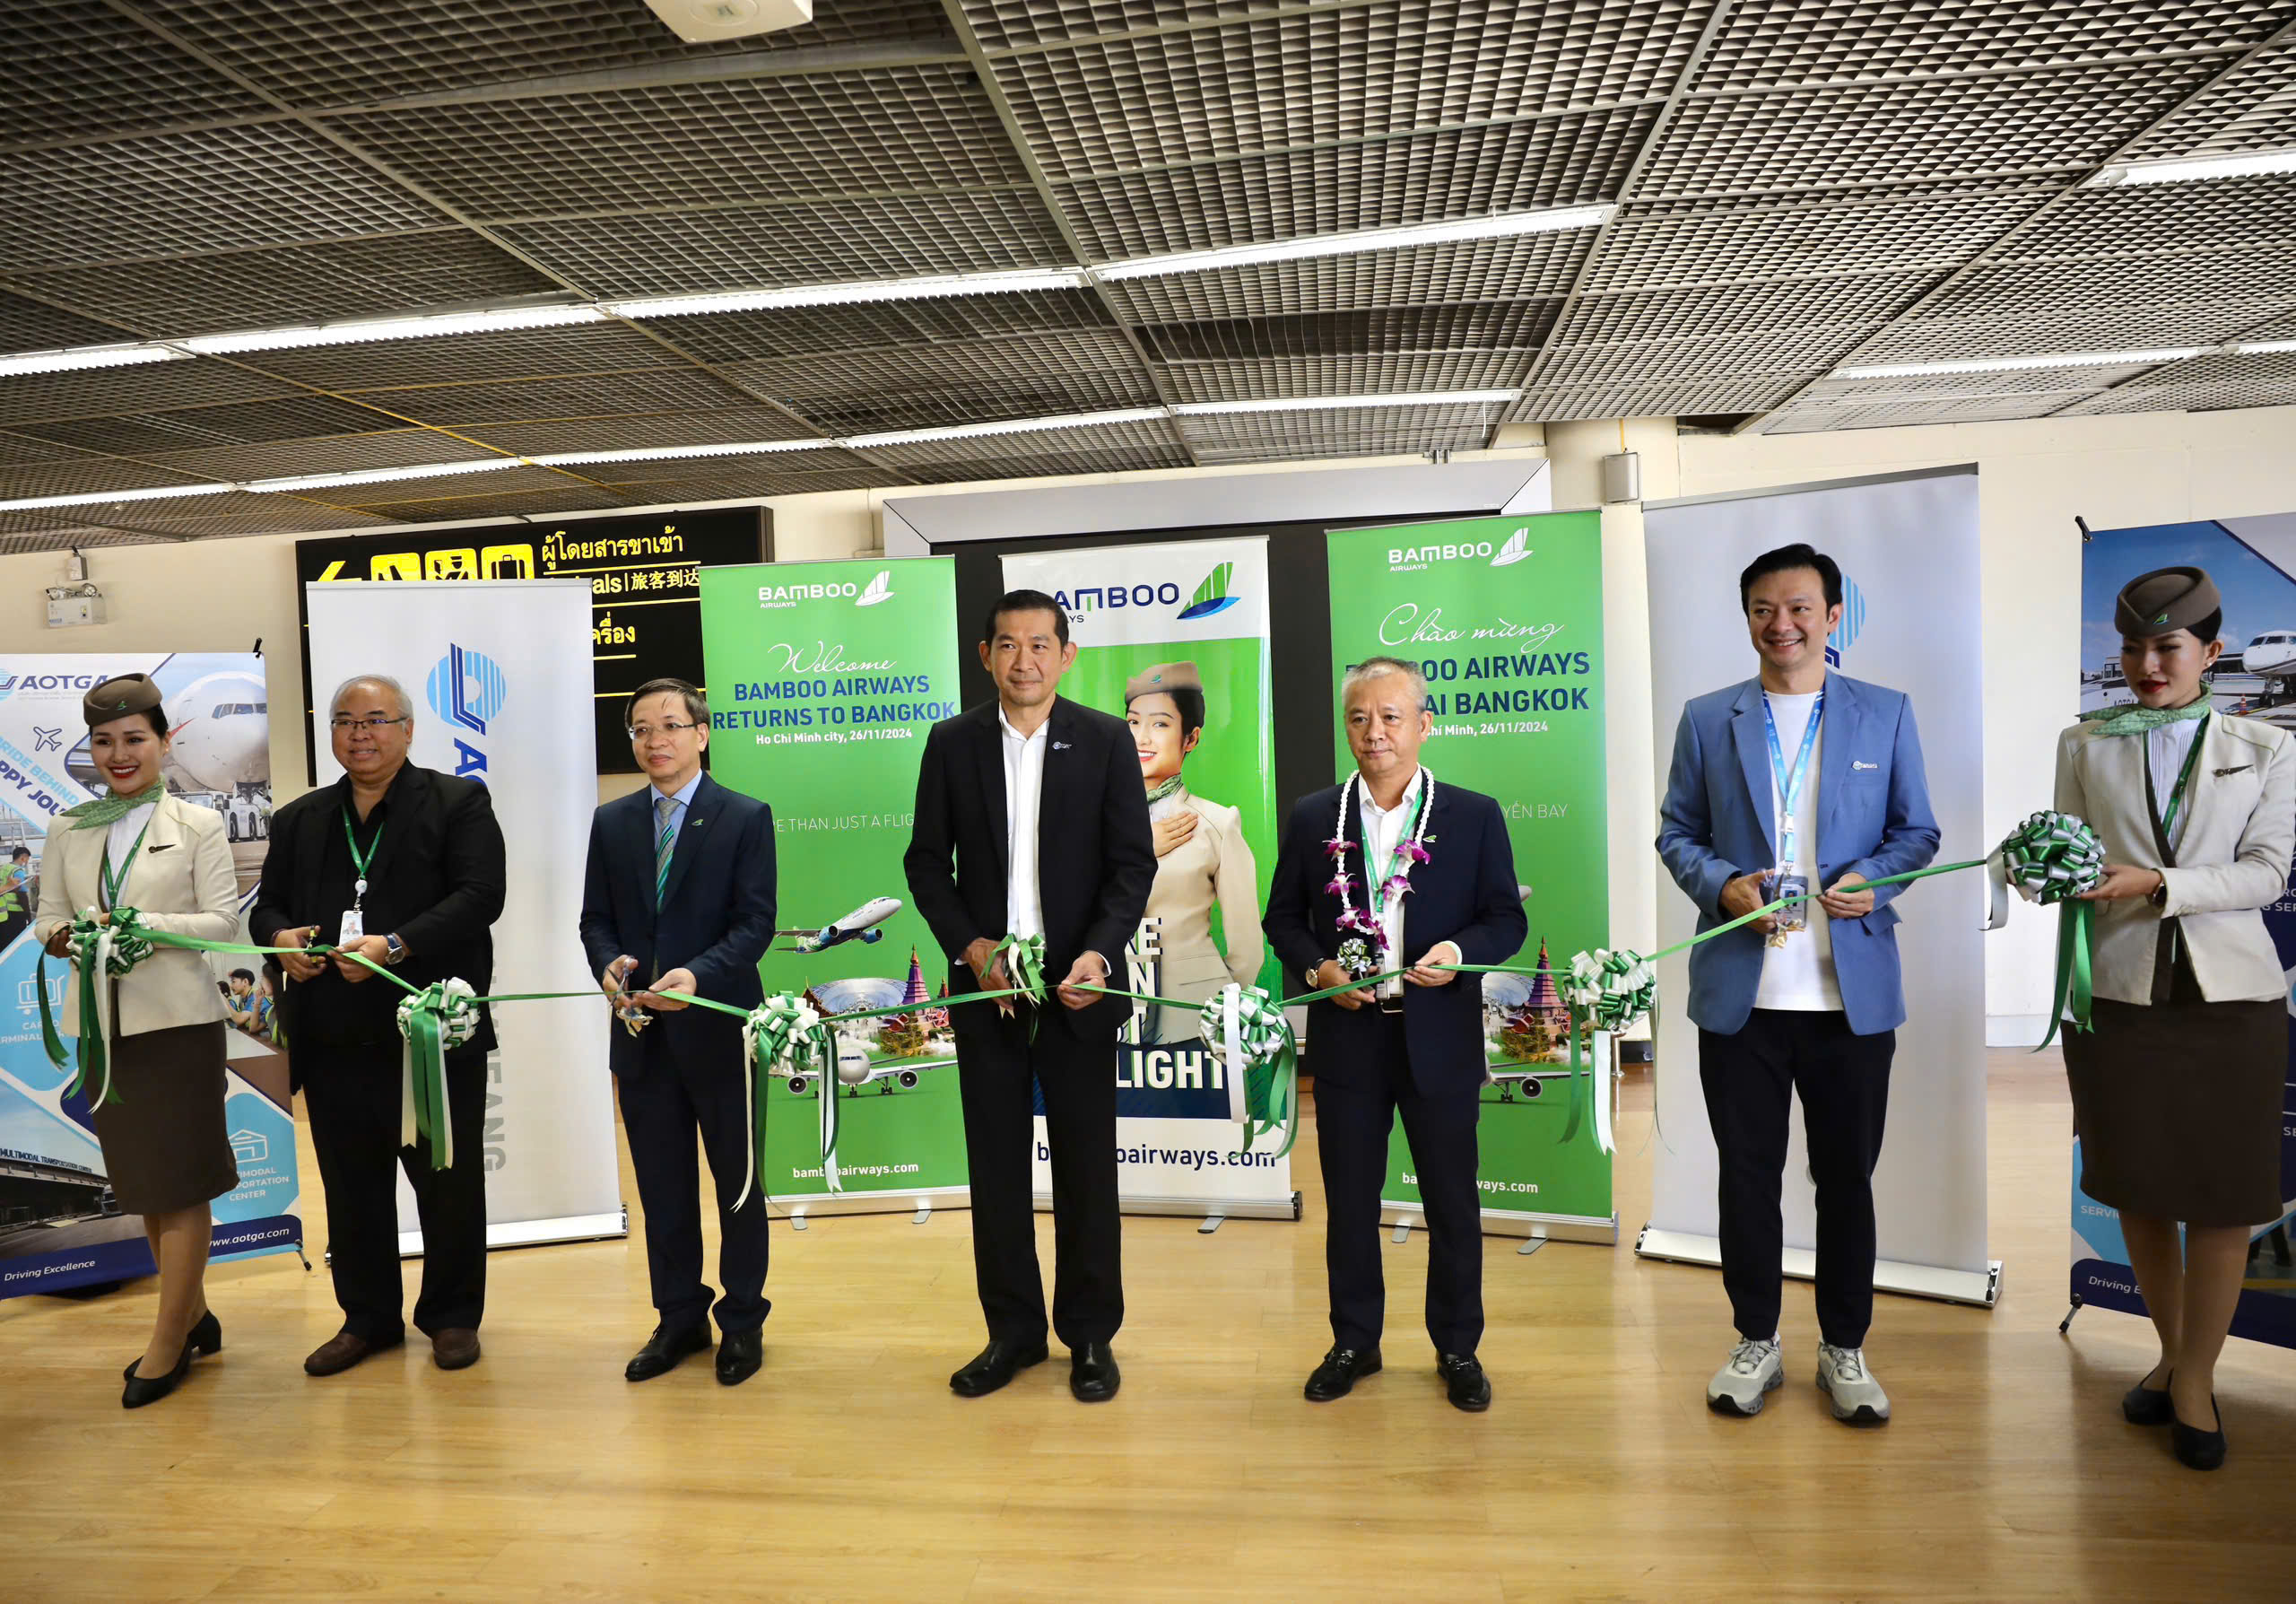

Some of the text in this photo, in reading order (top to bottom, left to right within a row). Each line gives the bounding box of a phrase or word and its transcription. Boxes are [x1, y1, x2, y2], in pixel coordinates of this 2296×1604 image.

[542, 526, 683, 571] ผู้โดยสารขาเข้า
[1388, 542, 1492, 563] BAMBOO
[1389, 563, 1428, 572] AIRWAYS
[758, 582, 857, 600] BAMBOO
[760, 601, 797, 609] AIRWAYS
[1378, 603, 1466, 646] Chào
[767, 641, 898, 674] Welcome
[1464, 652, 1590, 679] AIRWAYS
[735, 675, 930, 701] BAMBOO AIRWAYS
[1455, 687, 1589, 715] BANGKOK
[712, 702, 955, 729] RETURNS TO BANGKOK
[756, 728, 912, 745] Ho Chi Minh city, 26/11/2024
[1445, 724, 1478, 737] Minh,
[1480, 720, 1549, 734] 26/11/2024
[0, 735, 33, 768] RIDE
[1537, 803, 1569, 819] BAY
[788, 817, 829, 833] THAN
[831, 815, 868, 830] JUST
[871, 815, 882, 828] A
[229, 1190, 266, 1201] CENTER
[4, 1260, 96, 1281] Driving Excellence
[2088, 1276, 2132, 1294] Driving
